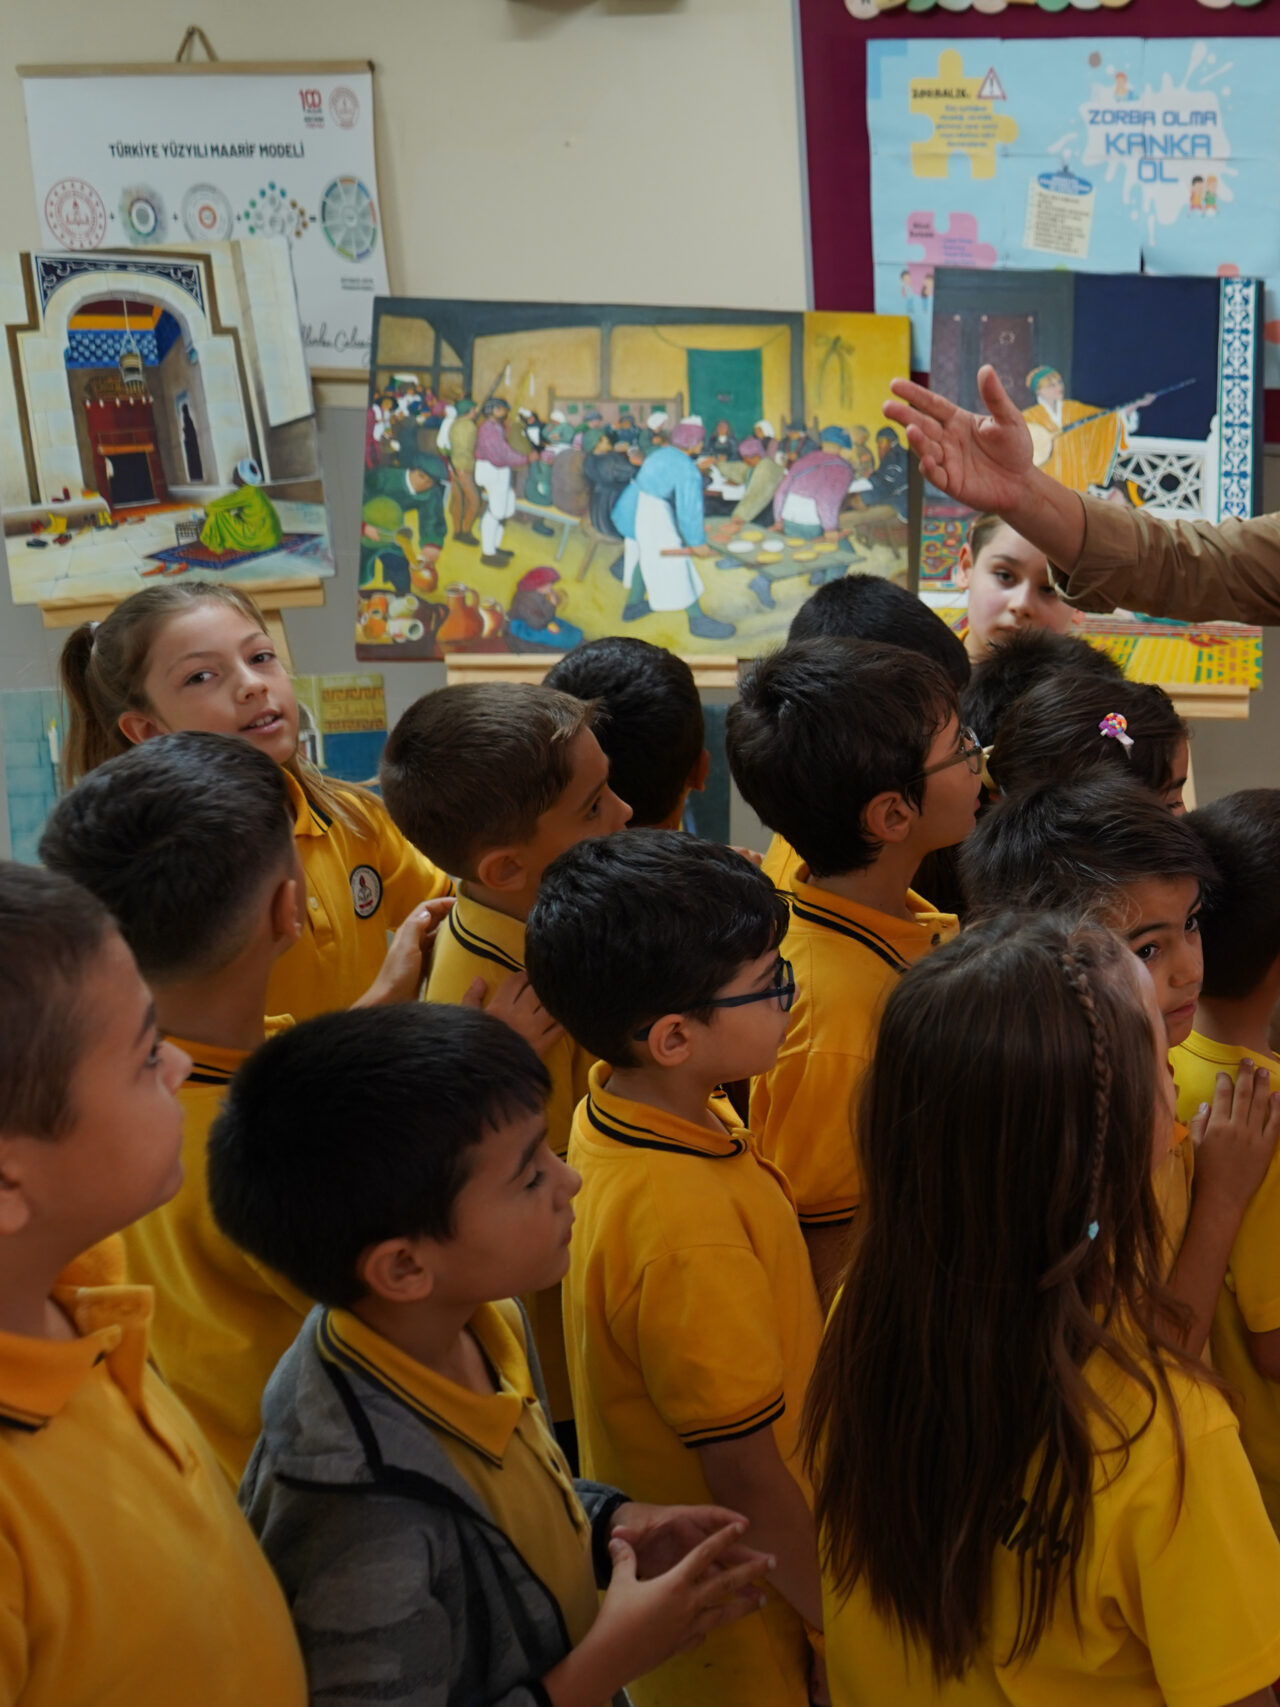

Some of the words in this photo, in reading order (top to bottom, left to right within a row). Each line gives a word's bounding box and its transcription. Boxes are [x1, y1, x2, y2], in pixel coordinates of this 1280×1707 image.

[1088, 109, 1155, 126] ZORBA
[1162, 110, 1217, 127] OLMA
[109, 140, 159, 159] TÜRKİYE
[162, 140, 208, 159] YÜZYILI
[210, 140, 256, 159] MAARİF
[259, 140, 305, 159] MODELİ
[1105, 132, 1211, 157] KANKA
[1138, 160, 1179, 183] OL
